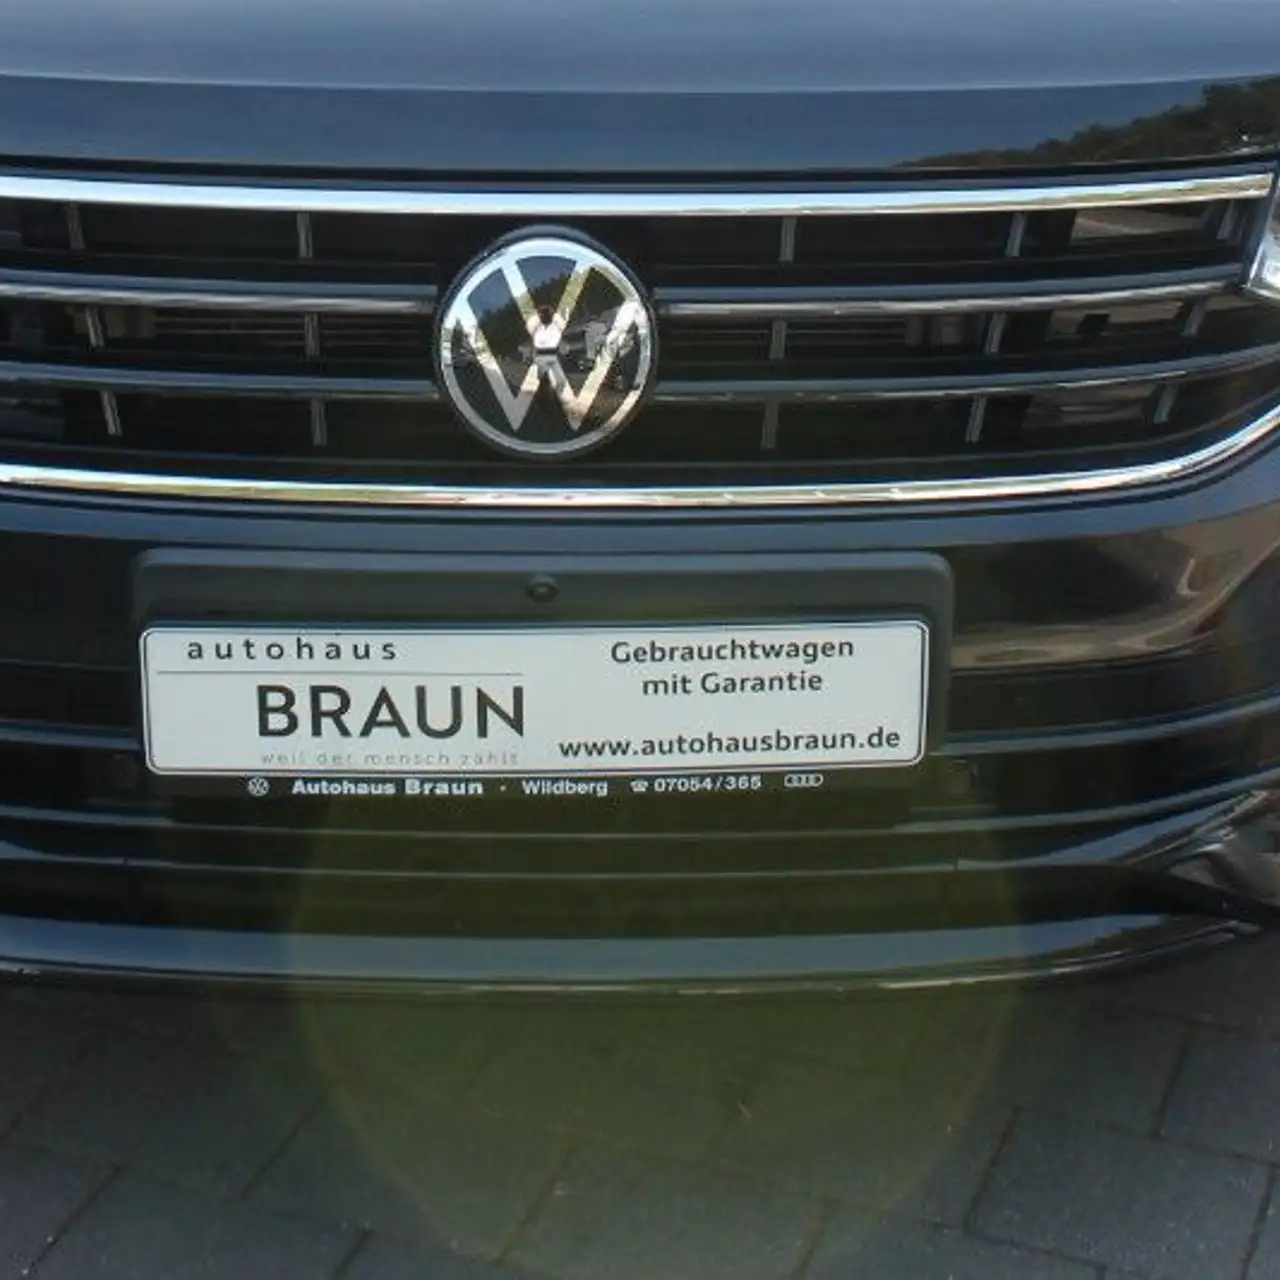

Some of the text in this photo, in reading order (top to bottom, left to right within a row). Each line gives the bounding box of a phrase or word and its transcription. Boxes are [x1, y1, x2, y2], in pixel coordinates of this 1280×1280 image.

[440, 234, 655, 456] VW
[187, 636, 398, 661] autohaus
[610, 637, 856, 666] Gebrauchtwagen
[642, 670, 824, 696] mit Garantie
[256, 684, 525, 740] BRAUN
[558, 726, 902, 758] www.autohausbraun.de
[292, 779, 396, 795] Autohaus
[404, 778, 484, 795] Braun
[522, 778, 608, 796] Wildberg
